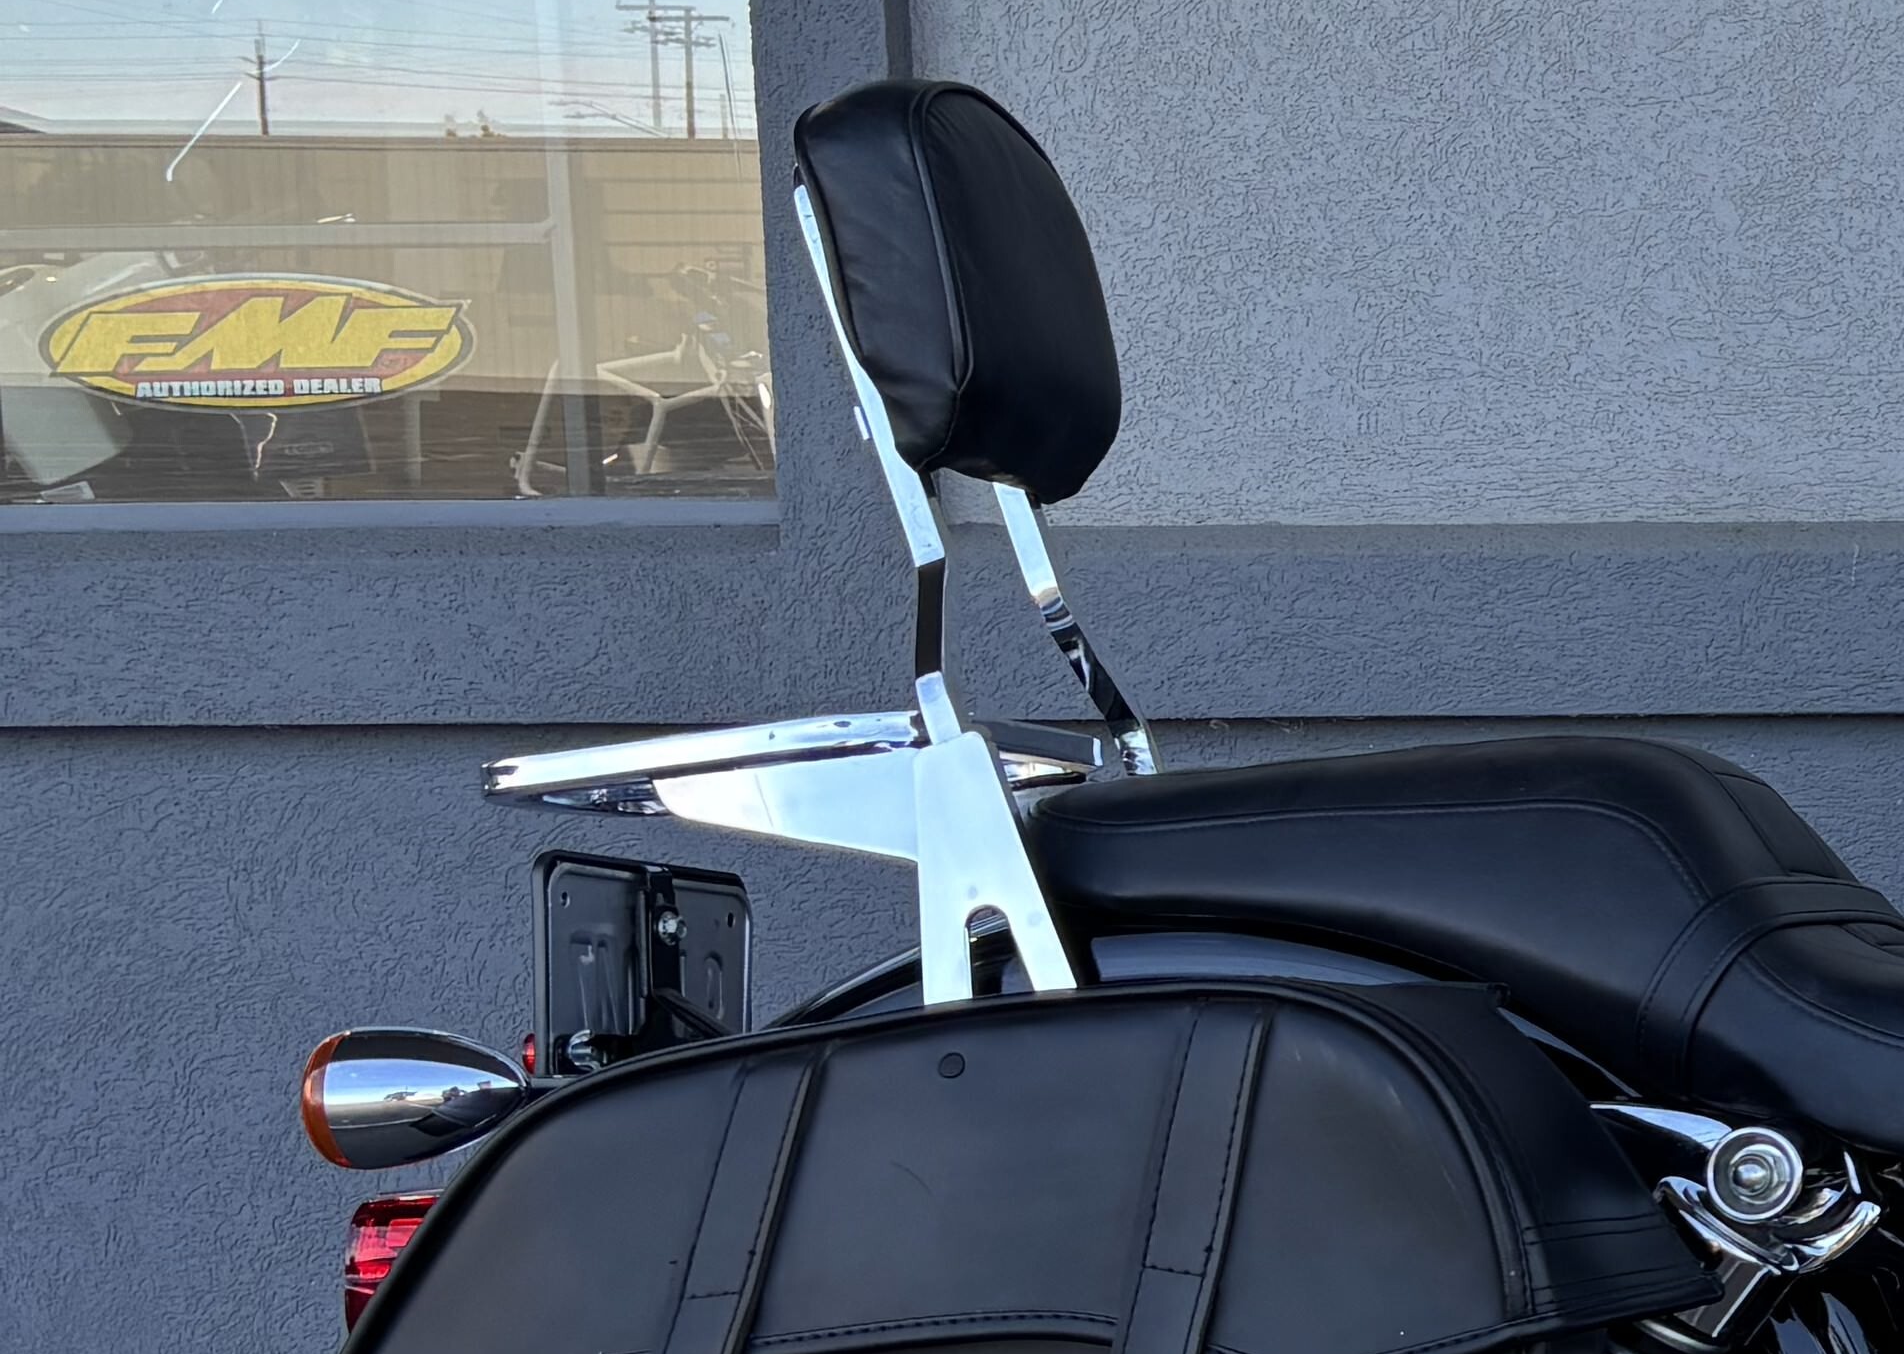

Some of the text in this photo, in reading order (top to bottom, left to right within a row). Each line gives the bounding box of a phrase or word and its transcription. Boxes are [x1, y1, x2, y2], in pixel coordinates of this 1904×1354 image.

[54, 293, 462, 375] FMF
[136, 377, 382, 398] AUTHORIZED DEALER
